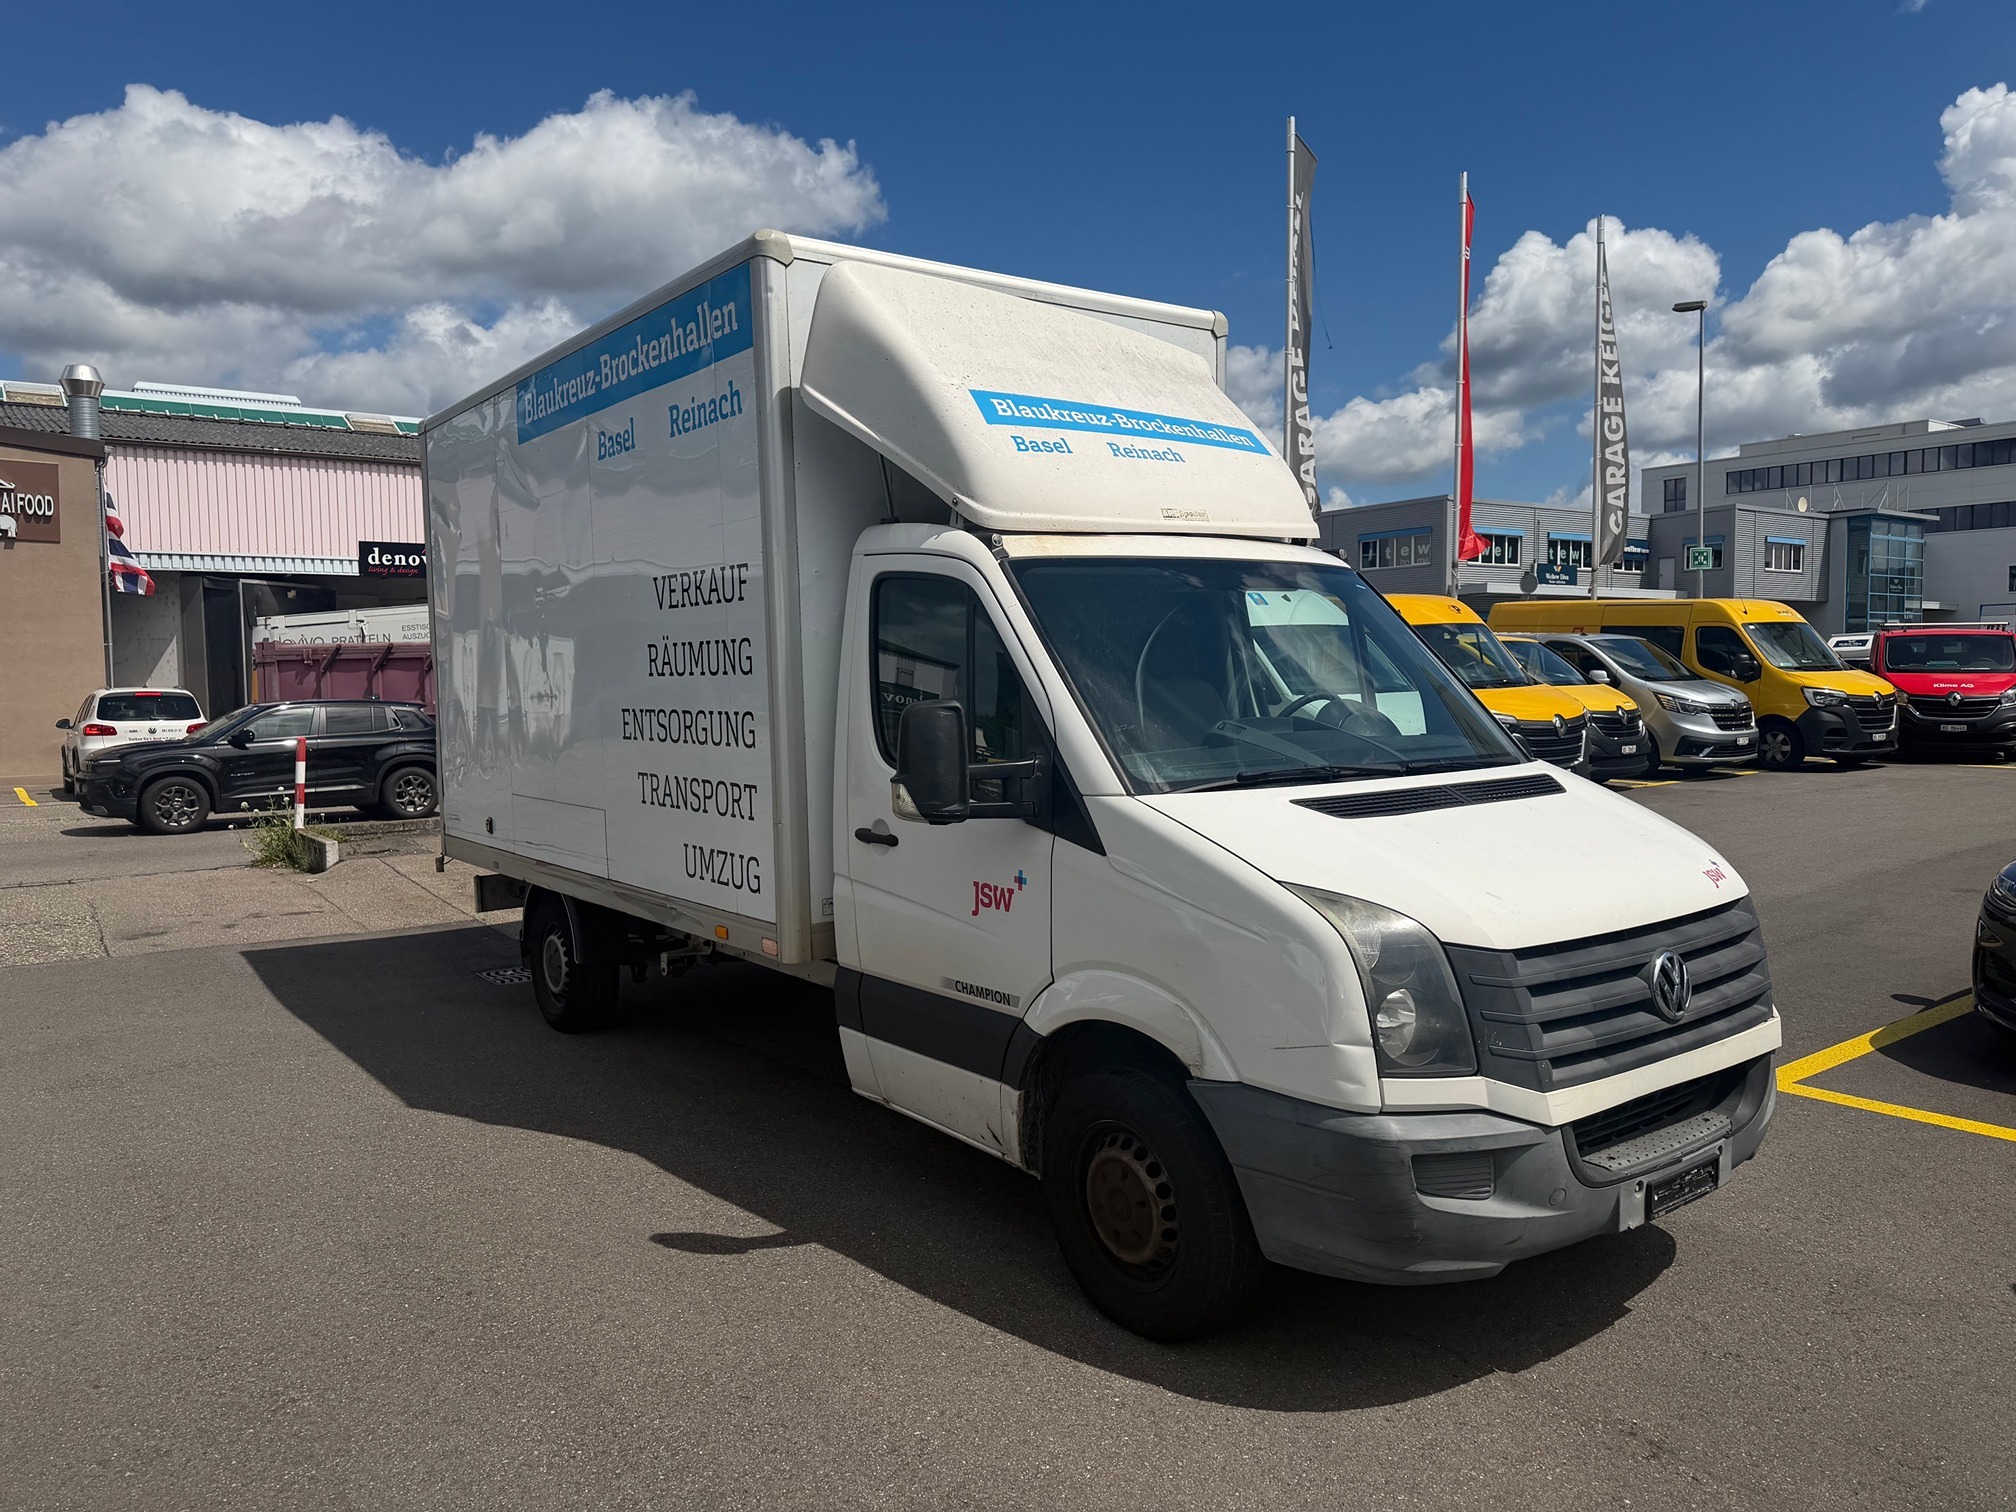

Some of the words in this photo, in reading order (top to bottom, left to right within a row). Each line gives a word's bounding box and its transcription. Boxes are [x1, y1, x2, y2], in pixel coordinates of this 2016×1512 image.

[523, 300, 739, 426] Blaukreuz-Brockenhallen
[597, 416, 636, 462] Basel
[668, 379, 744, 439] Reinach
[989, 397, 1256, 448] Blaukreuz-Brockenhallen
[1010, 434, 1074, 455] Basel
[1106, 441, 1187, 464] Reinach
[1602, 396, 1626, 536] GARAGE
[16, 492, 54, 516] FOOD
[652, 562, 749, 611] VERKAUF
[331, 632, 391, 645] PRATELN
[647, 635, 753, 677] RÄUMUNG
[621, 708, 756, 749] ENTSORGUNG
[638, 771, 758, 821] TRANSPORT
[683, 842, 762, 895] UMZUG
[954, 980, 1011, 1007] CHAMPION
